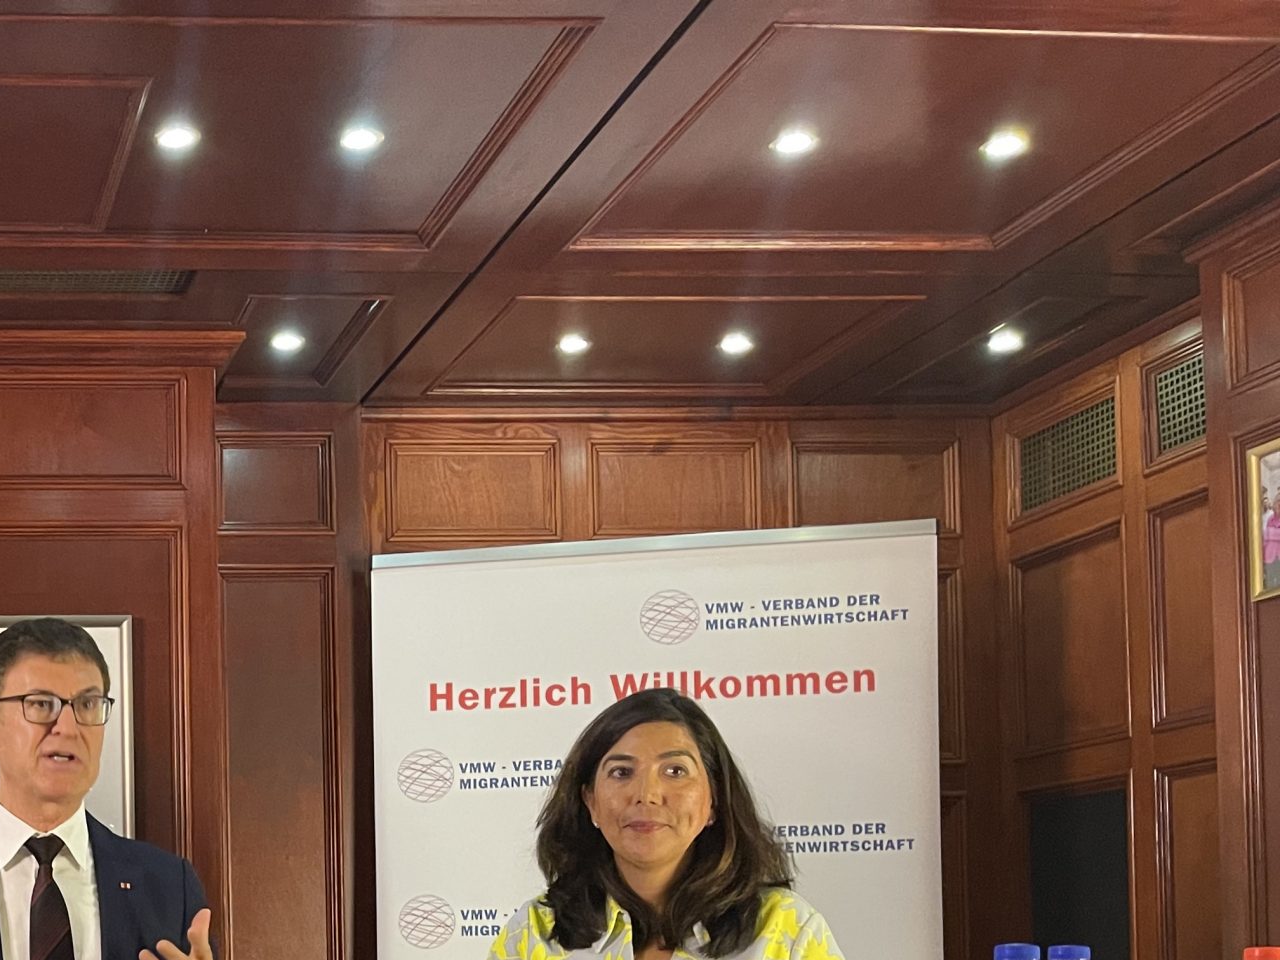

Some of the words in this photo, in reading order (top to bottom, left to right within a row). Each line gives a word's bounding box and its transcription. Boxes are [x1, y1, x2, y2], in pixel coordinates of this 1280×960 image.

[705, 602, 744, 614] VMW
[762, 596, 840, 611] VERBAND
[847, 594, 880, 607] DER
[705, 609, 909, 630] MIGRANTENWIRTSCHAFT
[430, 676, 591, 711] Herzlich
[609, 669, 875, 701] Willkommen
[459, 762, 496, 773] VMW
[512, 759, 563, 771] VERBA
[852, 823, 886, 835] DER
[782, 838, 915, 853] ENWIRTSCHAFT
[460, 909, 497, 920] VMW
[461, 925, 501, 936] MIGR
